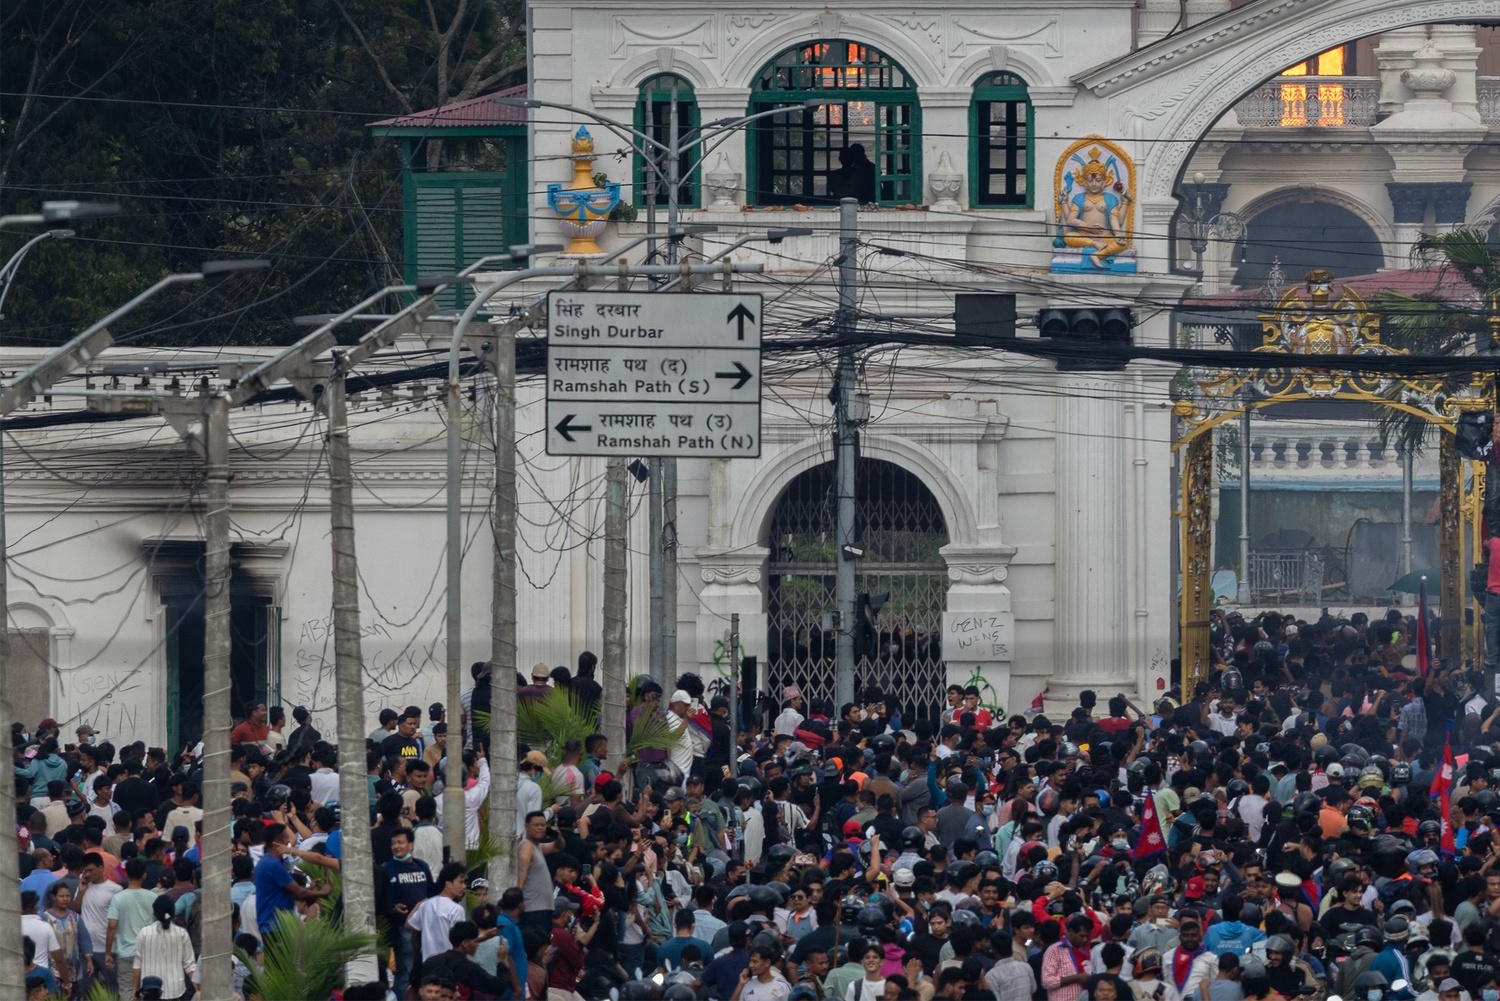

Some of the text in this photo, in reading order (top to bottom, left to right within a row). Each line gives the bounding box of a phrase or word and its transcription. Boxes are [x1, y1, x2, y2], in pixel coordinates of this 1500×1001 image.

[554, 298, 642, 318] सिंह दरबार
[554, 324, 664, 340] Singh Durbar
[553, 357, 688, 376] रामशाह पथ (द)
[553, 378, 628, 393] Ramshah
[634, 379, 672, 393] Path
[598, 413, 733, 432] रामशाह पथ (उ)
[597, 433, 671, 448] Ramshah
[677, 435, 714, 449] Path
